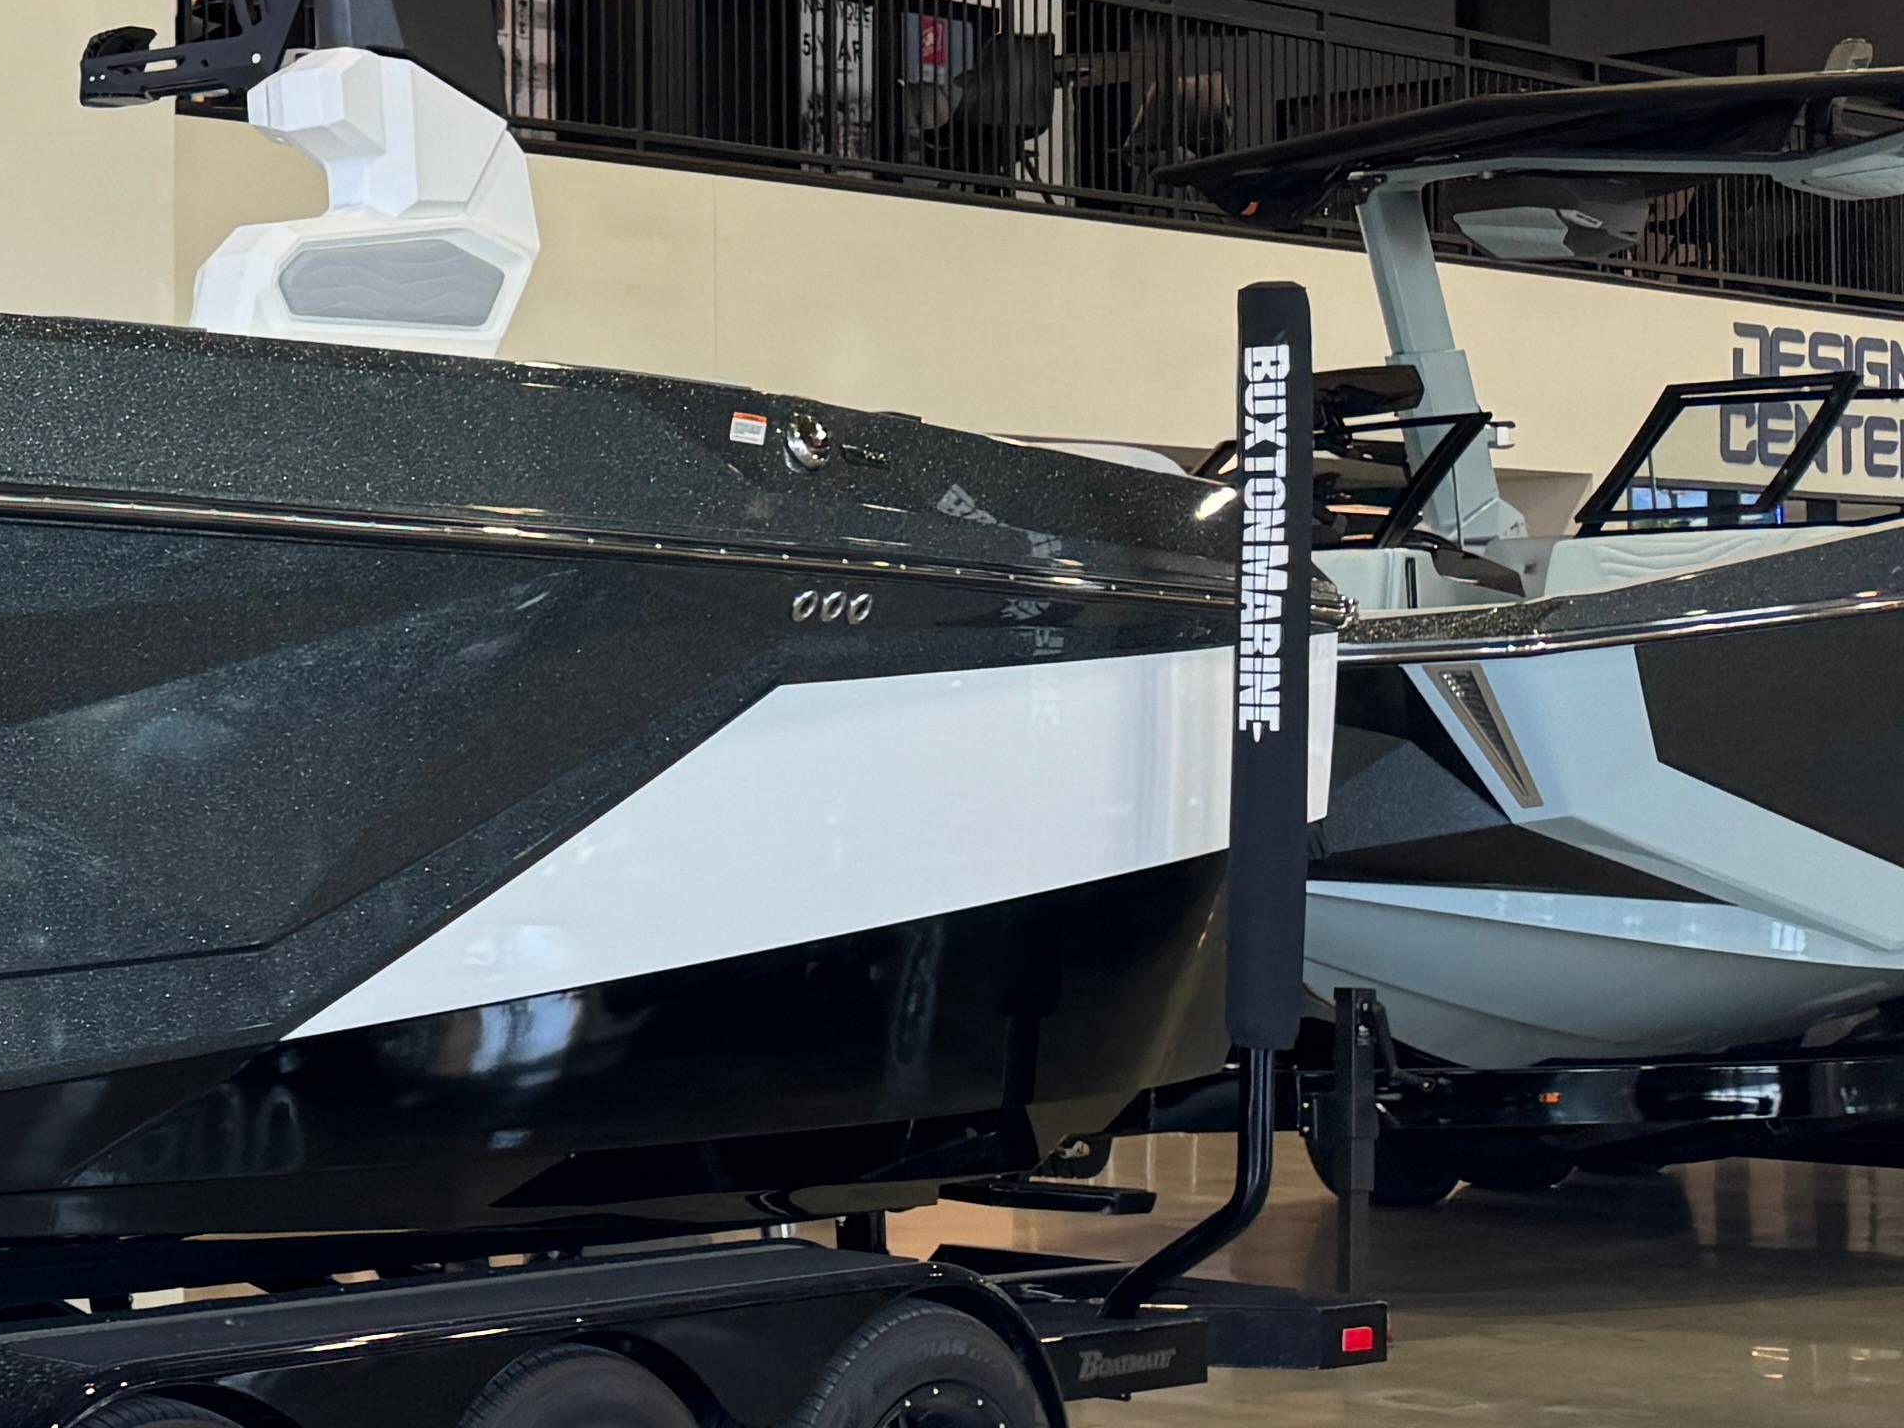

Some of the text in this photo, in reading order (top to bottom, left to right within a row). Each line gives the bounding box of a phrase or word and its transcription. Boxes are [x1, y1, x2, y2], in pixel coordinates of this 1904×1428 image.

[814, 35, 861, 63] YAR
[1720, 403, 1904, 479] CENTE
[1238, 344, 1291, 733] BUXTONMARINE
